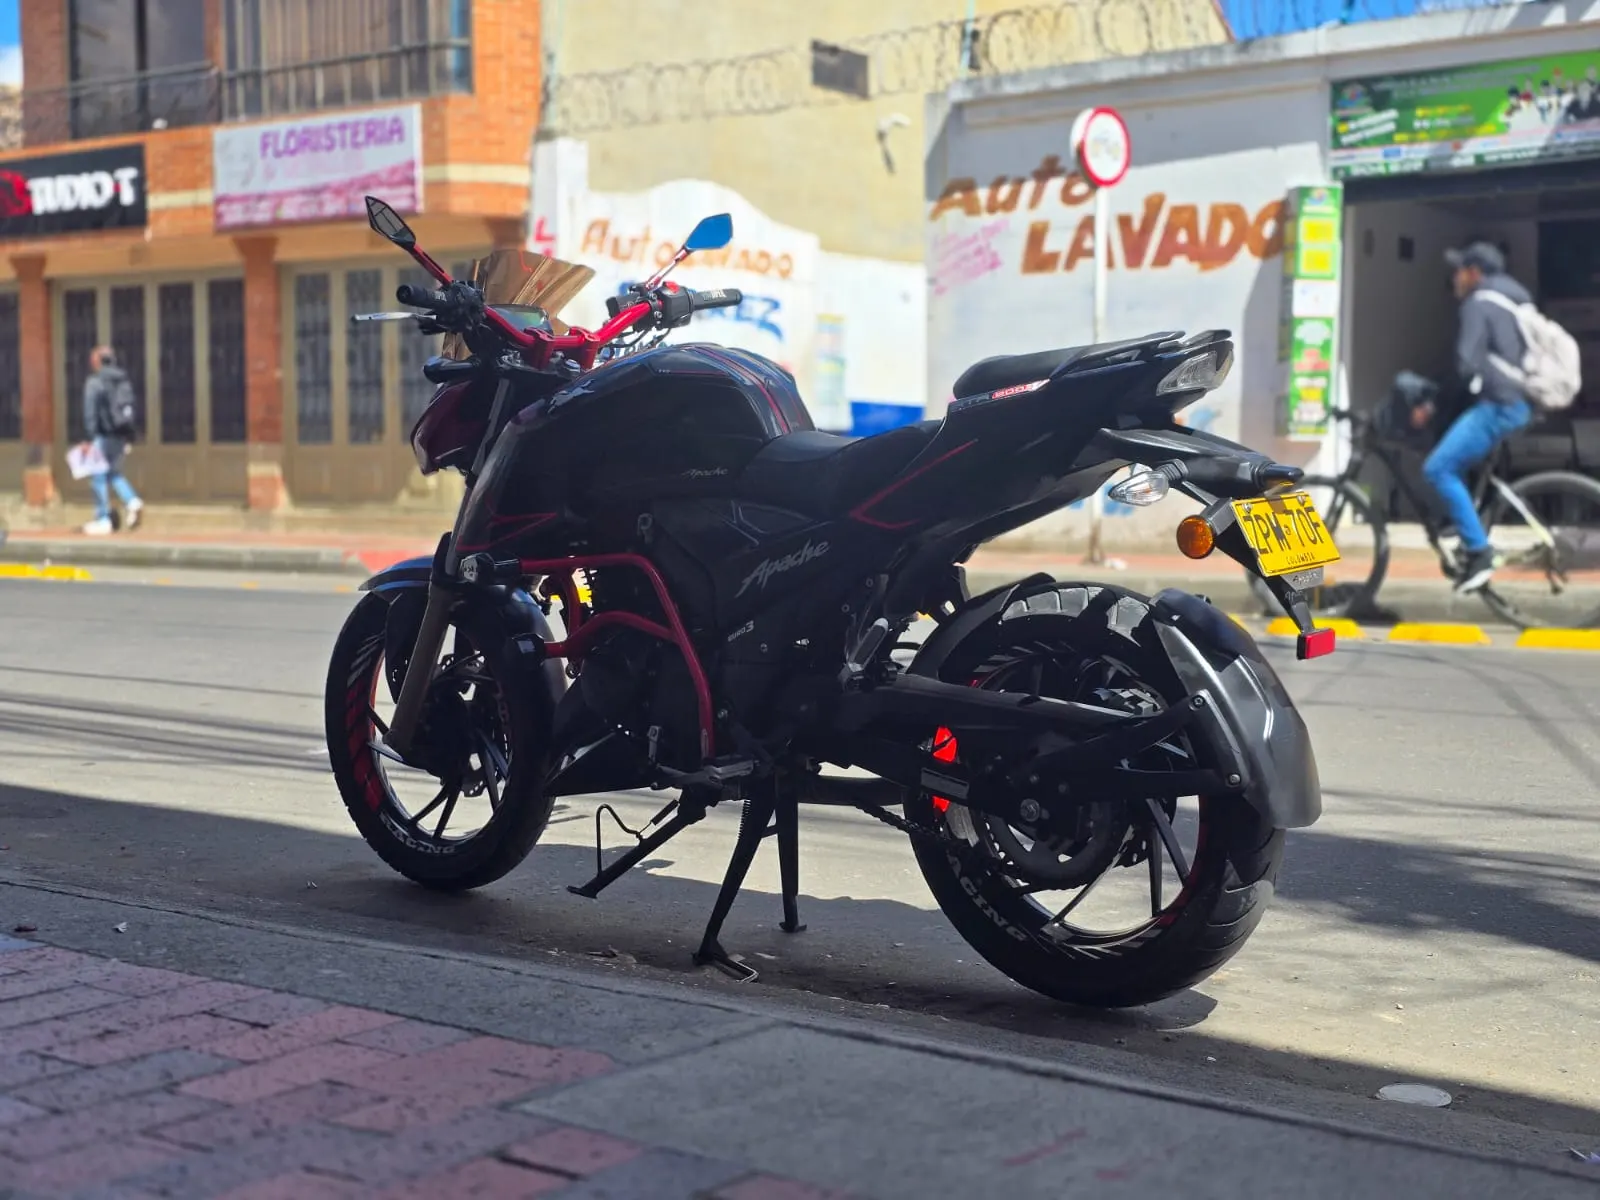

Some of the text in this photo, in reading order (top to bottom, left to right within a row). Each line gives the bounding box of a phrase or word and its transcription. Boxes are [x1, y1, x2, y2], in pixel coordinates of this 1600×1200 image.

[260, 115, 406, 158] FLORISTERIA
[930, 154, 1097, 221] Auto
[1021, 191, 1287, 276] LAVADO
[681, 467, 729, 480] Apache
[1242, 506, 1324, 555] ZPM 70F
[734, 537, 832, 599] Apache
[1286, 552, 1316, 565] COLOMBIA
[944, 848, 1028, 942] ACING
